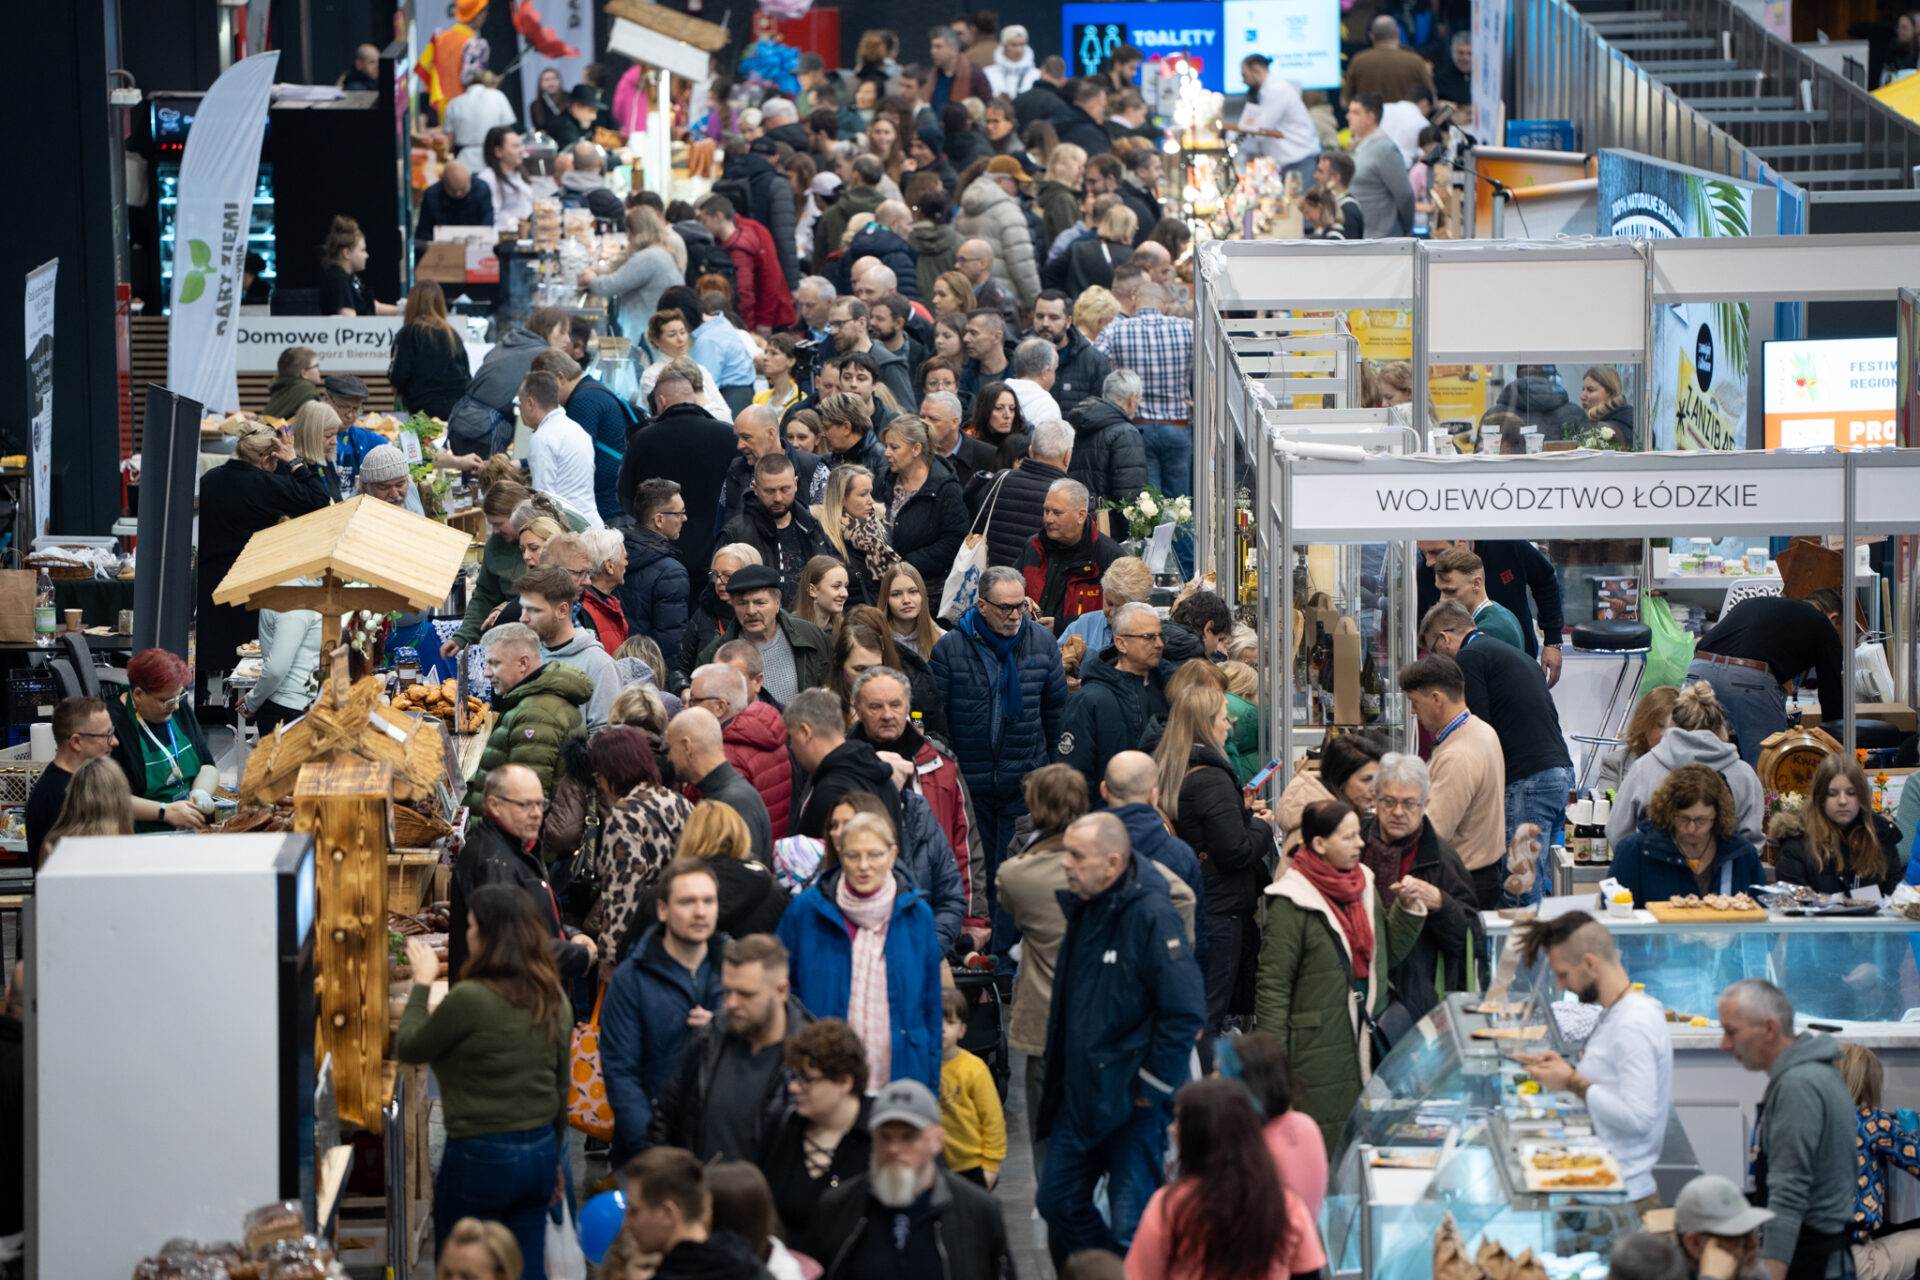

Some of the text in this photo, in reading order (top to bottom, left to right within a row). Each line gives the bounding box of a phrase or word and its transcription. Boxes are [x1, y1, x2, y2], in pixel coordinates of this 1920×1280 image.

[1132, 29, 1216, 47] TOALETY
[221, 203, 239, 266] ZIEMI
[236, 328, 397, 347] Domowe (Przy)
[1377, 480, 1758, 512] WOJEWÓDZTWO ŁÓDZKIE
